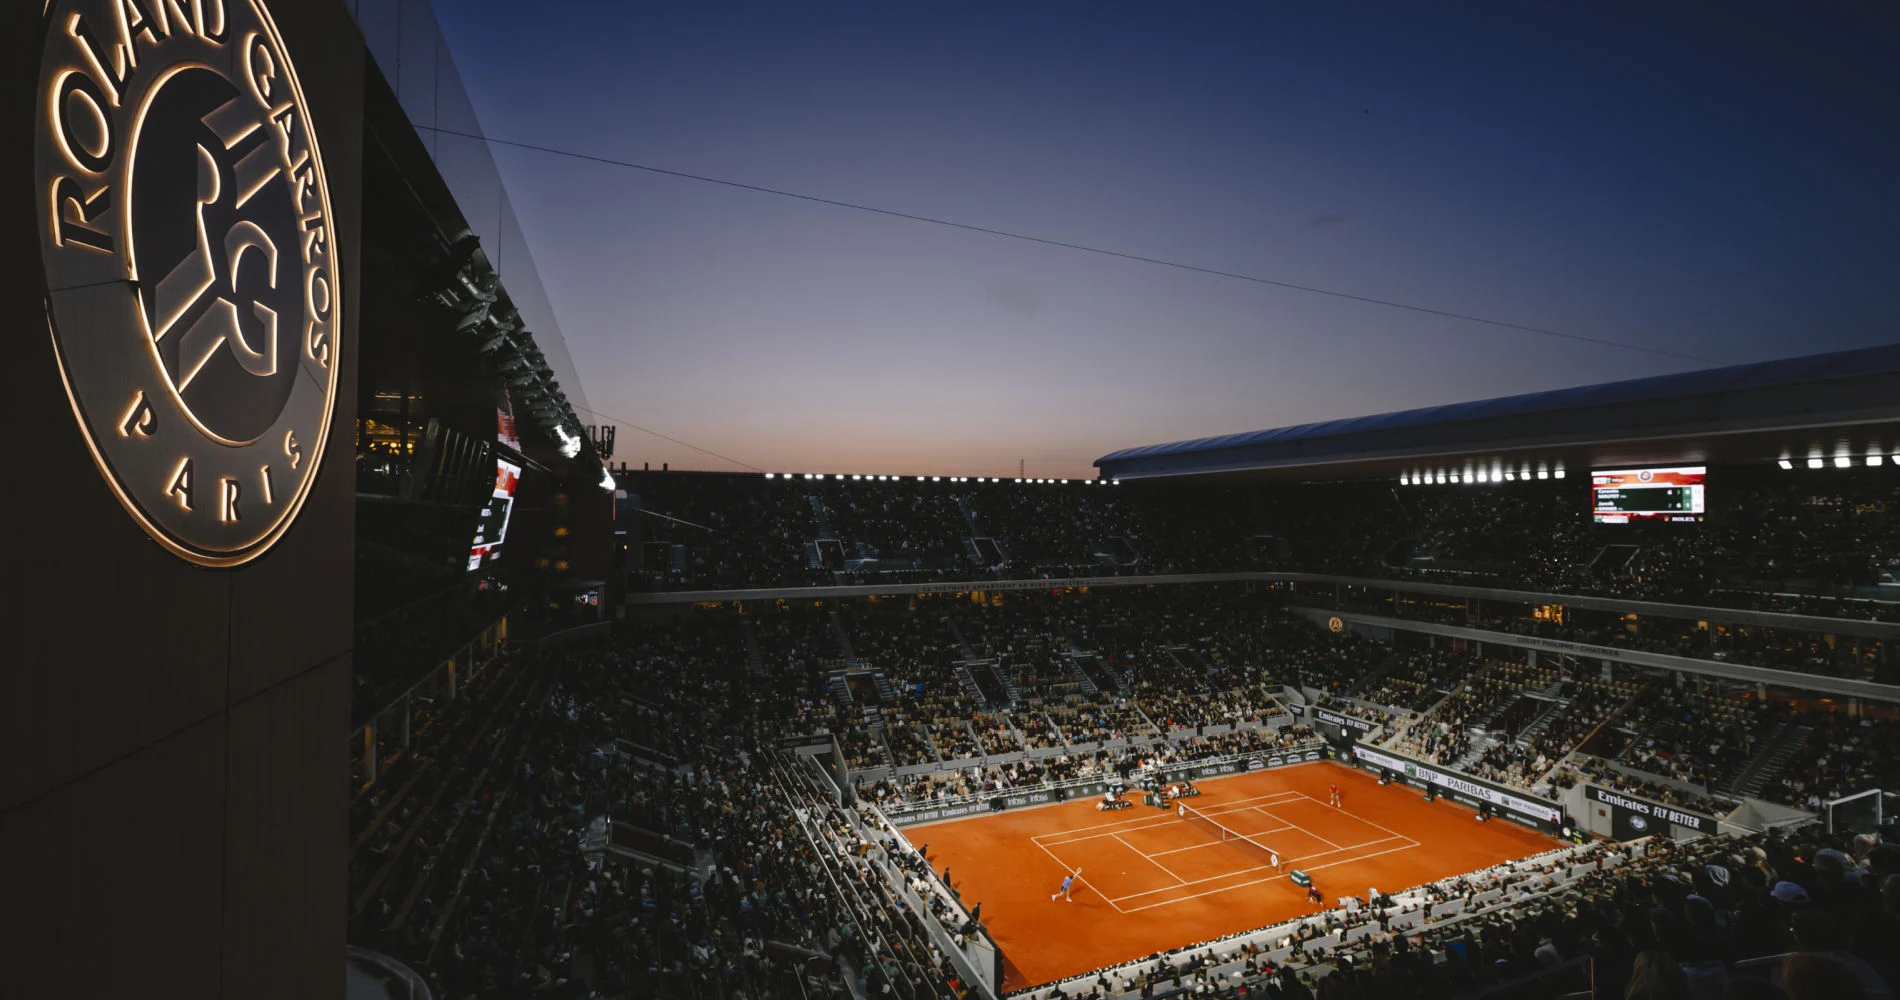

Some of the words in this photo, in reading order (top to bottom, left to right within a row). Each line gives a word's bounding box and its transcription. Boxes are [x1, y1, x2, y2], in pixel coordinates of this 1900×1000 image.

[51, 0, 232, 253] ROLAND
[243, 32, 331, 368] GARROS
[117, 390, 303, 522] PARIS
[1318, 711, 1345, 725] Emirates
[1418, 768, 1438, 782] BNP
[1447, 778, 1491, 800] PARIBAS
[942, 807, 968, 817] Emirates
[1597, 790, 1649, 814] Emirates
[1653, 806, 1667, 819] FLY
[1668, 810, 1700, 829] BETTER
